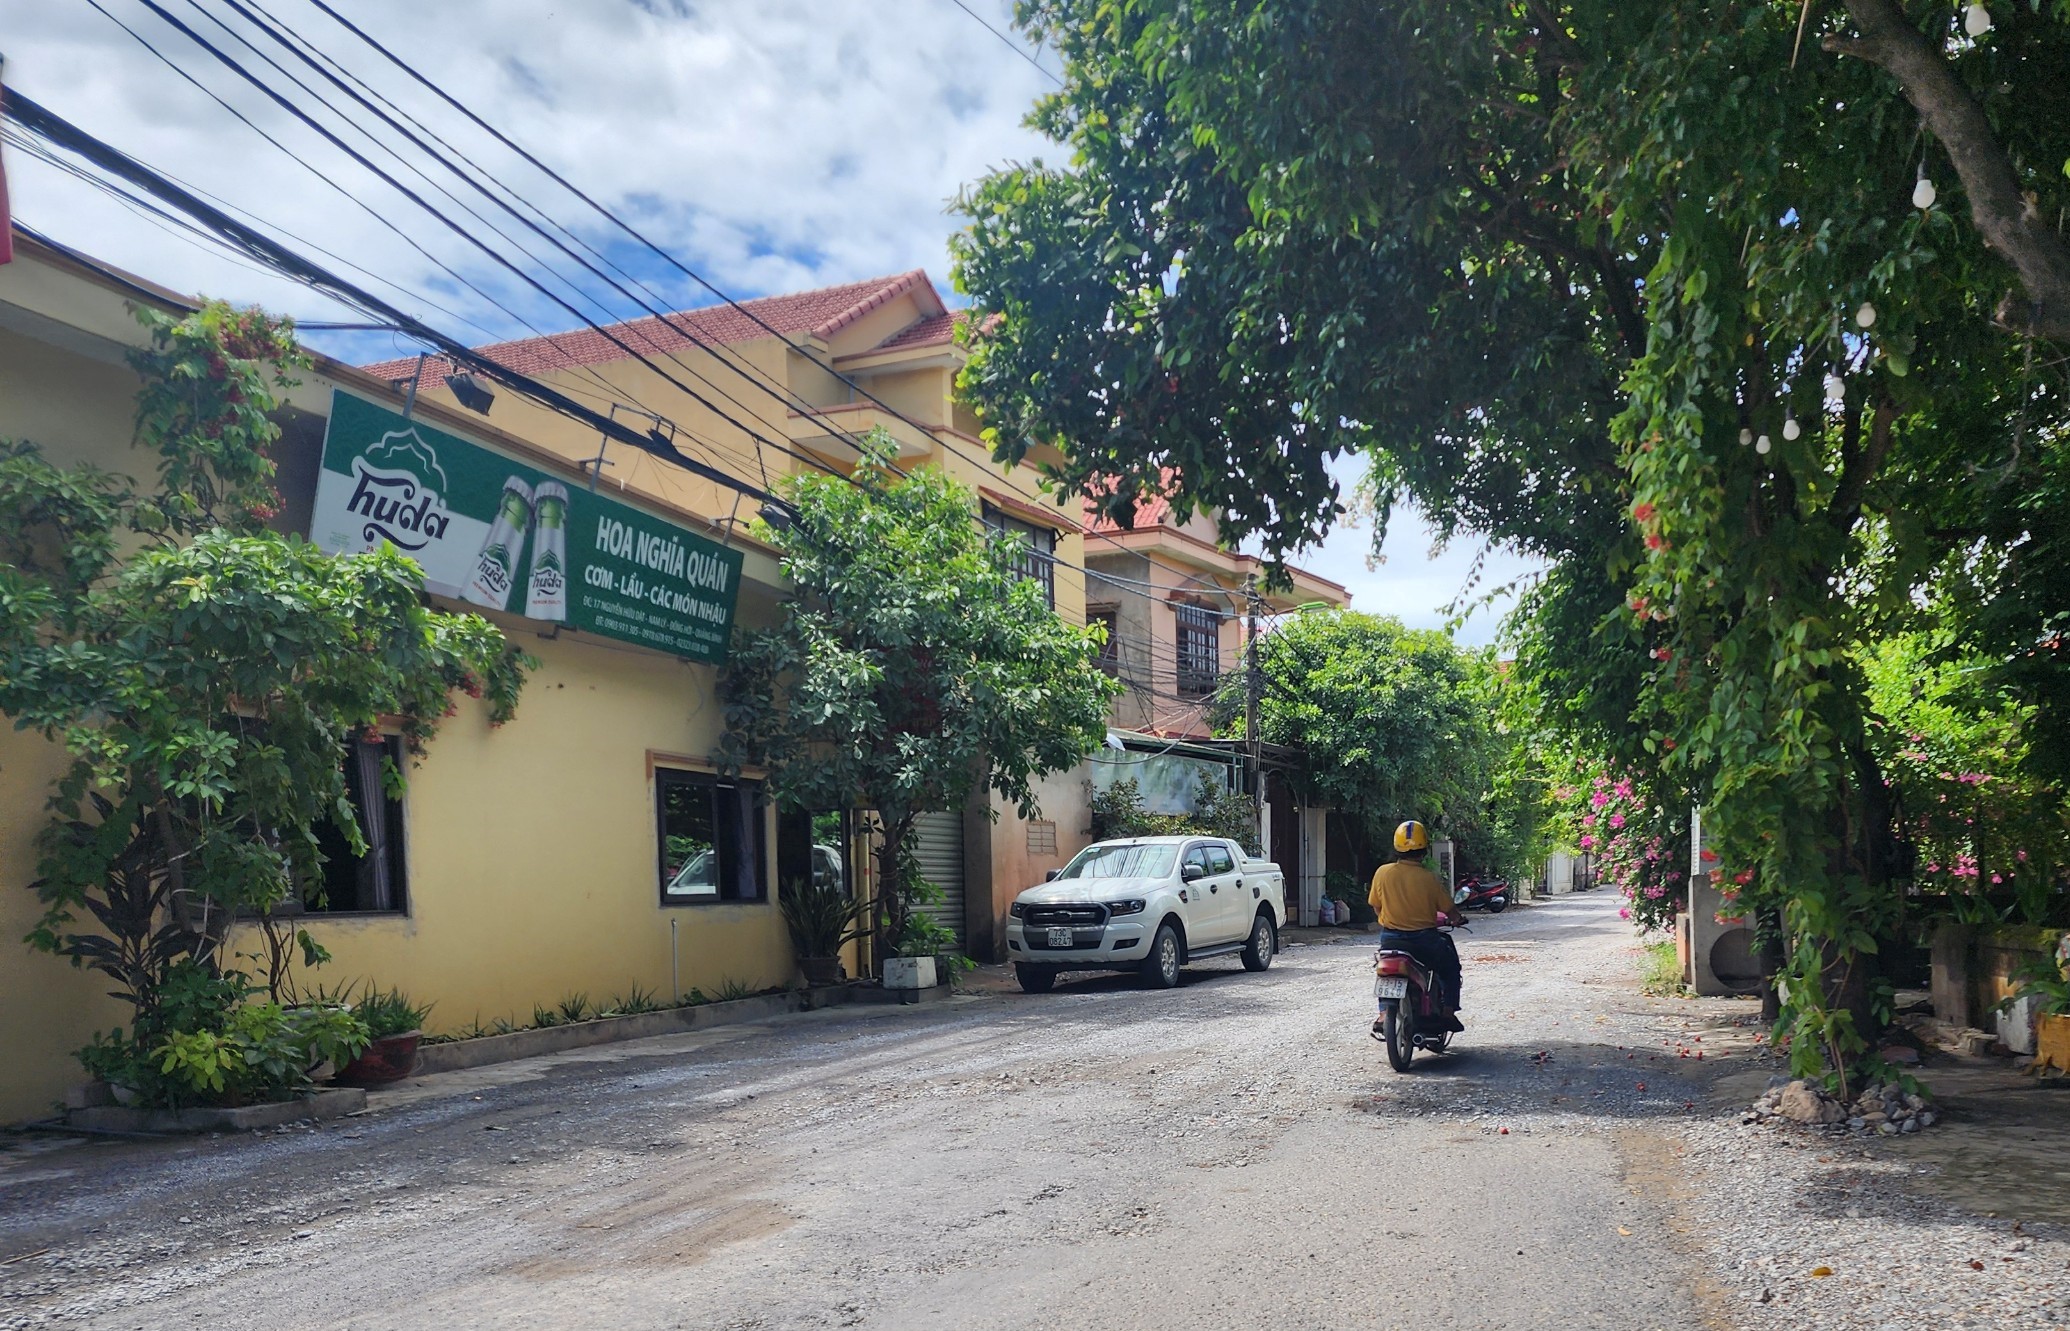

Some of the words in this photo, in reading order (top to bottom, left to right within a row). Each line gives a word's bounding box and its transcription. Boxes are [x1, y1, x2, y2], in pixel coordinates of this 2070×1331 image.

[346, 465, 450, 545] huda
[533, 570, 562, 589] huda
[596, 515, 633, 561] HOA
[635, 530, 685, 579] NGHĨA
[687, 551, 729, 593] QUÁN
[585, 564, 613, 590] CƠM
[650, 585, 672, 608] CÁC
[672, 593, 698, 616] MÓN
[698, 602, 726, 627] NHẬU
